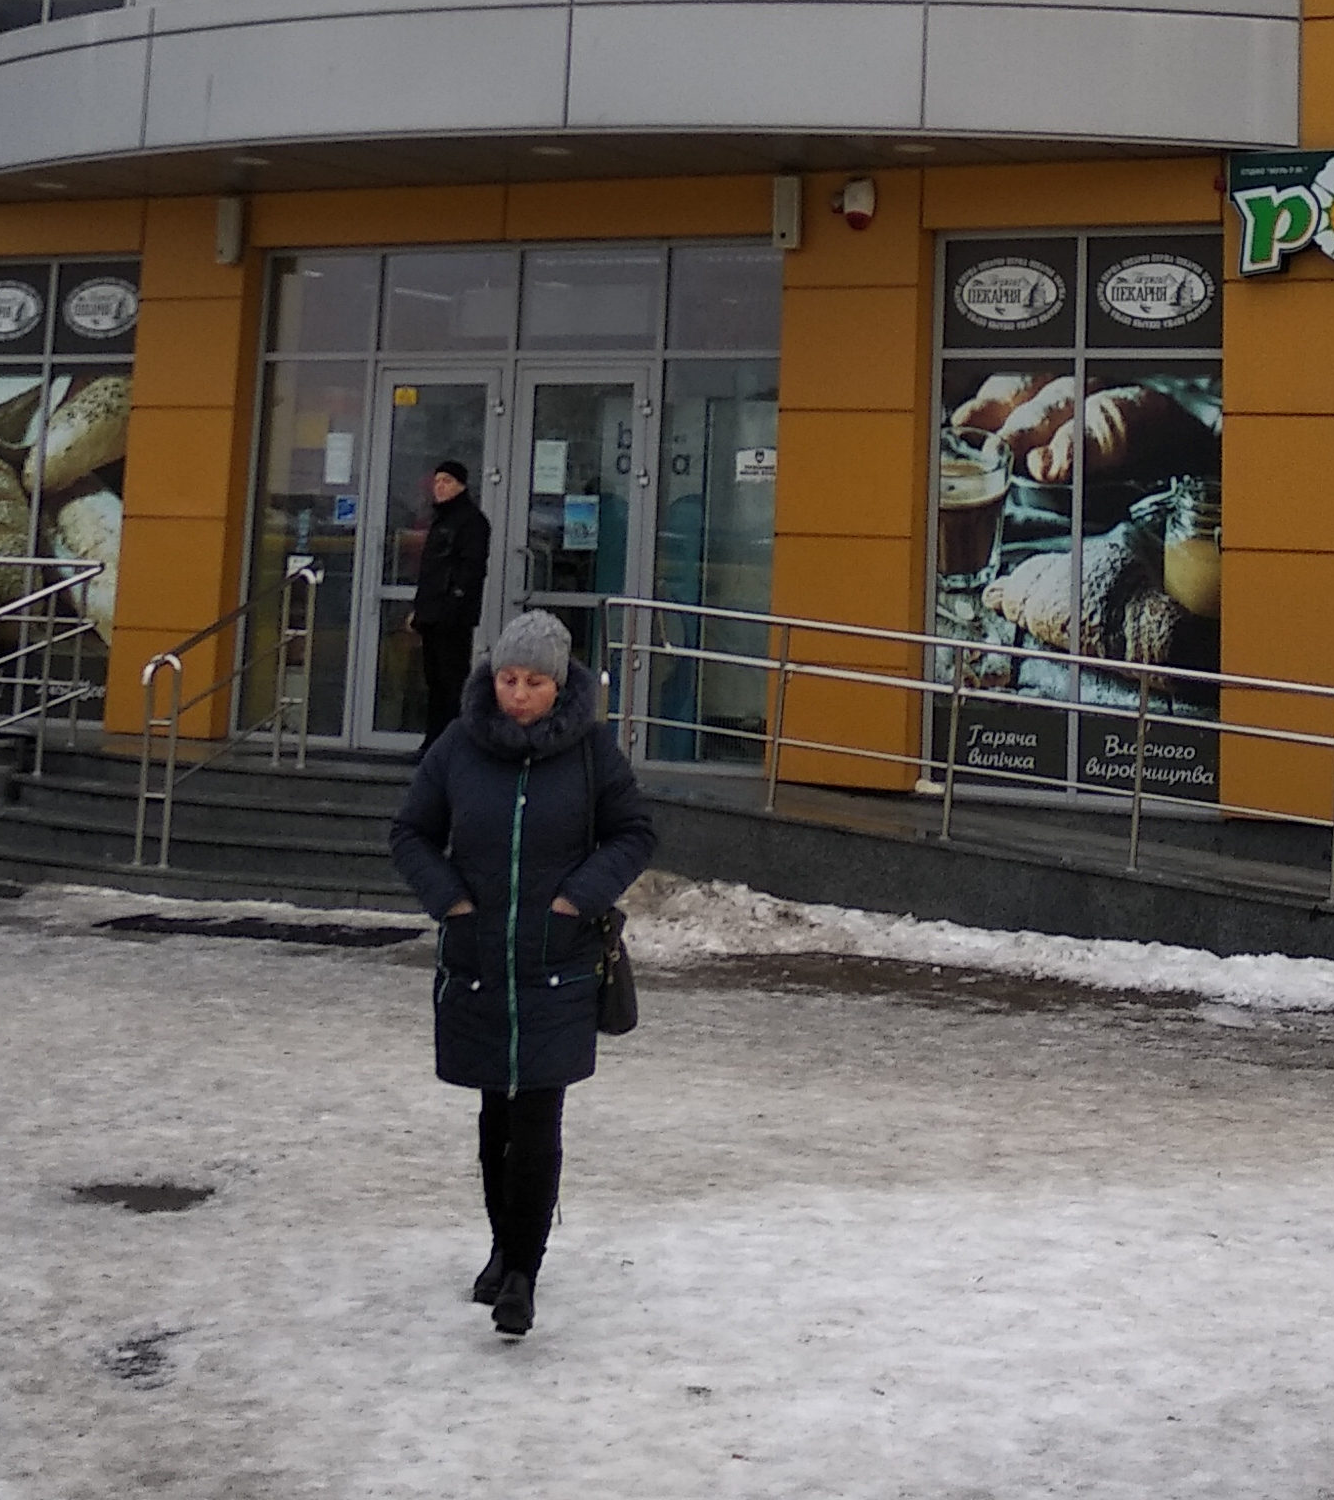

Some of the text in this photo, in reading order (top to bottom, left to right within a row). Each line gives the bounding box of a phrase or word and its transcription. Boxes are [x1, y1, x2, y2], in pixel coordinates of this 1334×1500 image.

[968, 287, 1021, 304] ПЕКАРНЯ
[1111, 286, 1168, 302] ПЕКАРНЯ
[967, 724, 1038, 748] Гаряча
[1104, 734, 1196, 760] Власного
[968, 747, 1035, 770] випічка
